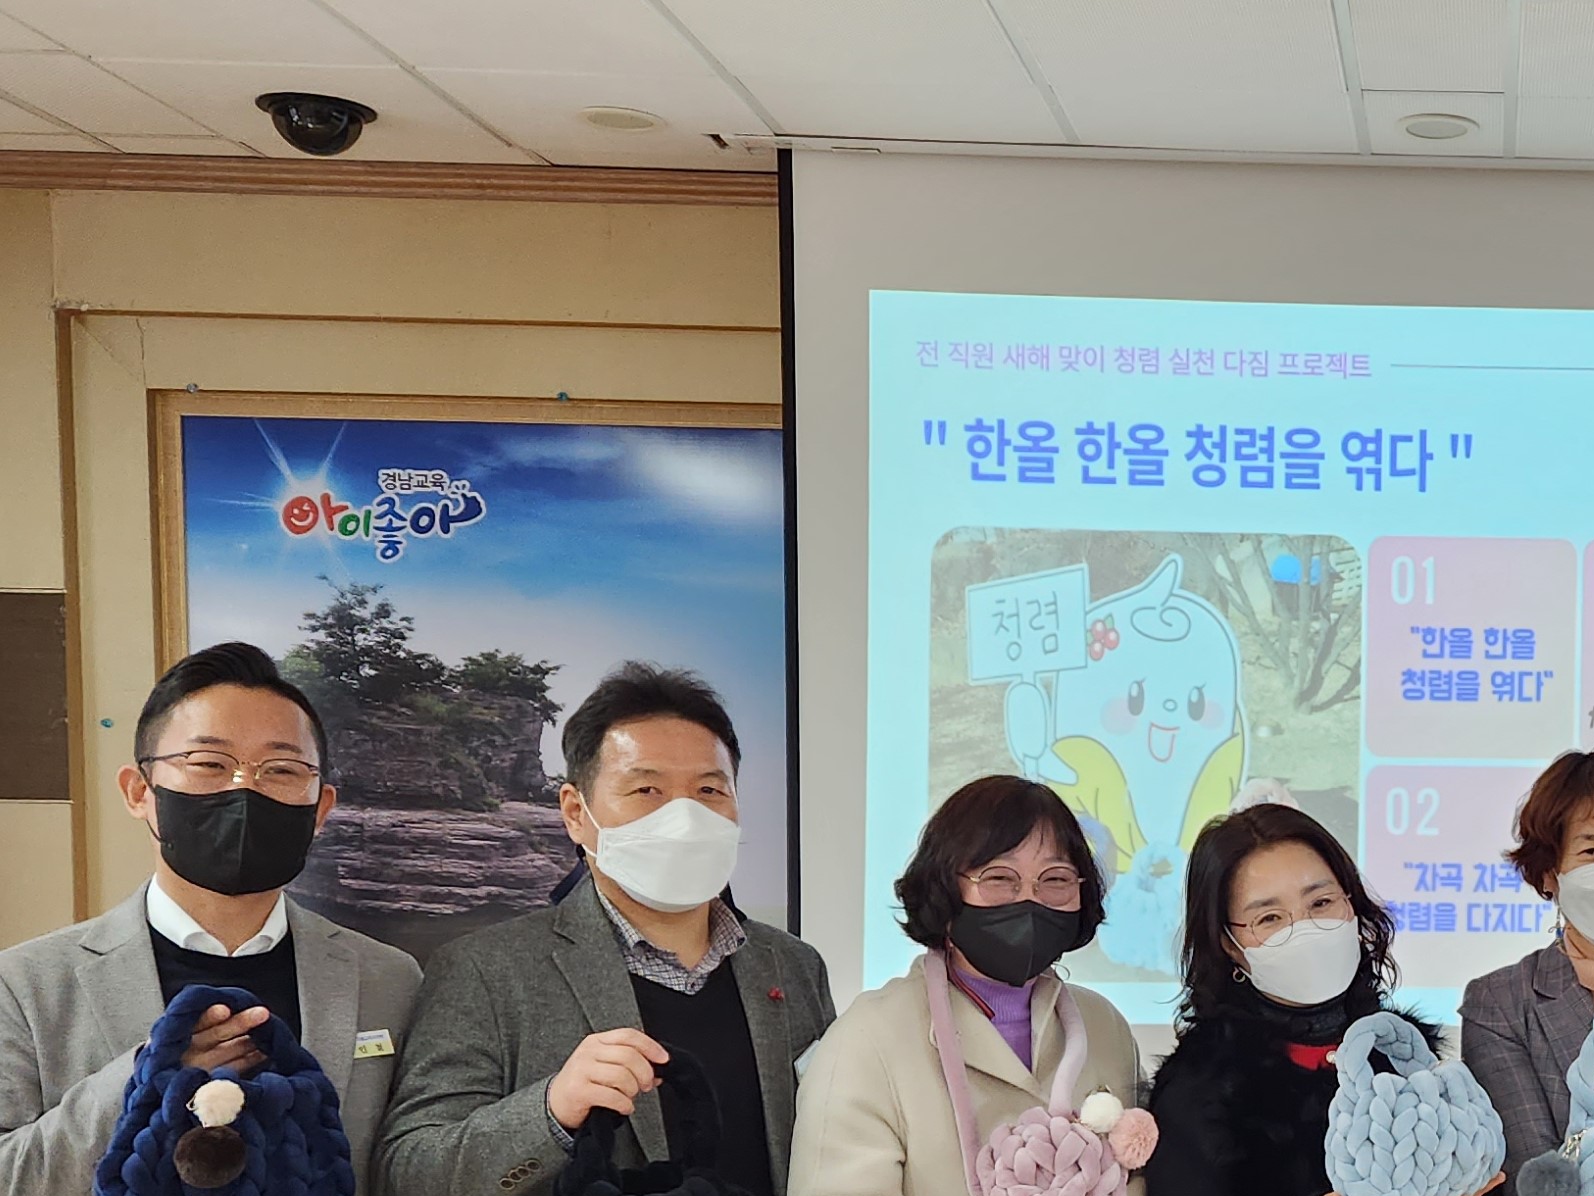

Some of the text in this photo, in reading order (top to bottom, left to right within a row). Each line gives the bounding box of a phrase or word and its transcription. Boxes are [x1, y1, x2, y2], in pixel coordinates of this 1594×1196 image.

[915, 340, 1373, 380] 전 직원 새해 맞이 청렴 실천 다짐 프로젝트
[963, 417, 1060, 484] 한올
[1074, 420, 1169, 487] 한올
[1184, 423, 1325, 490] 청렴을
[1340, 427, 1433, 492] 엮다
[381, 472, 448, 491] 경남교육
[282, 491, 484, 560] 아이좋아
[1391, 555, 1435, 605] 01
[990, 591, 1060, 662] 청렴
[1410, 626, 1536, 661] "한올 한올
[1401, 668, 1481, 702] 청렴을
[1386, 787, 1440, 836] 02
